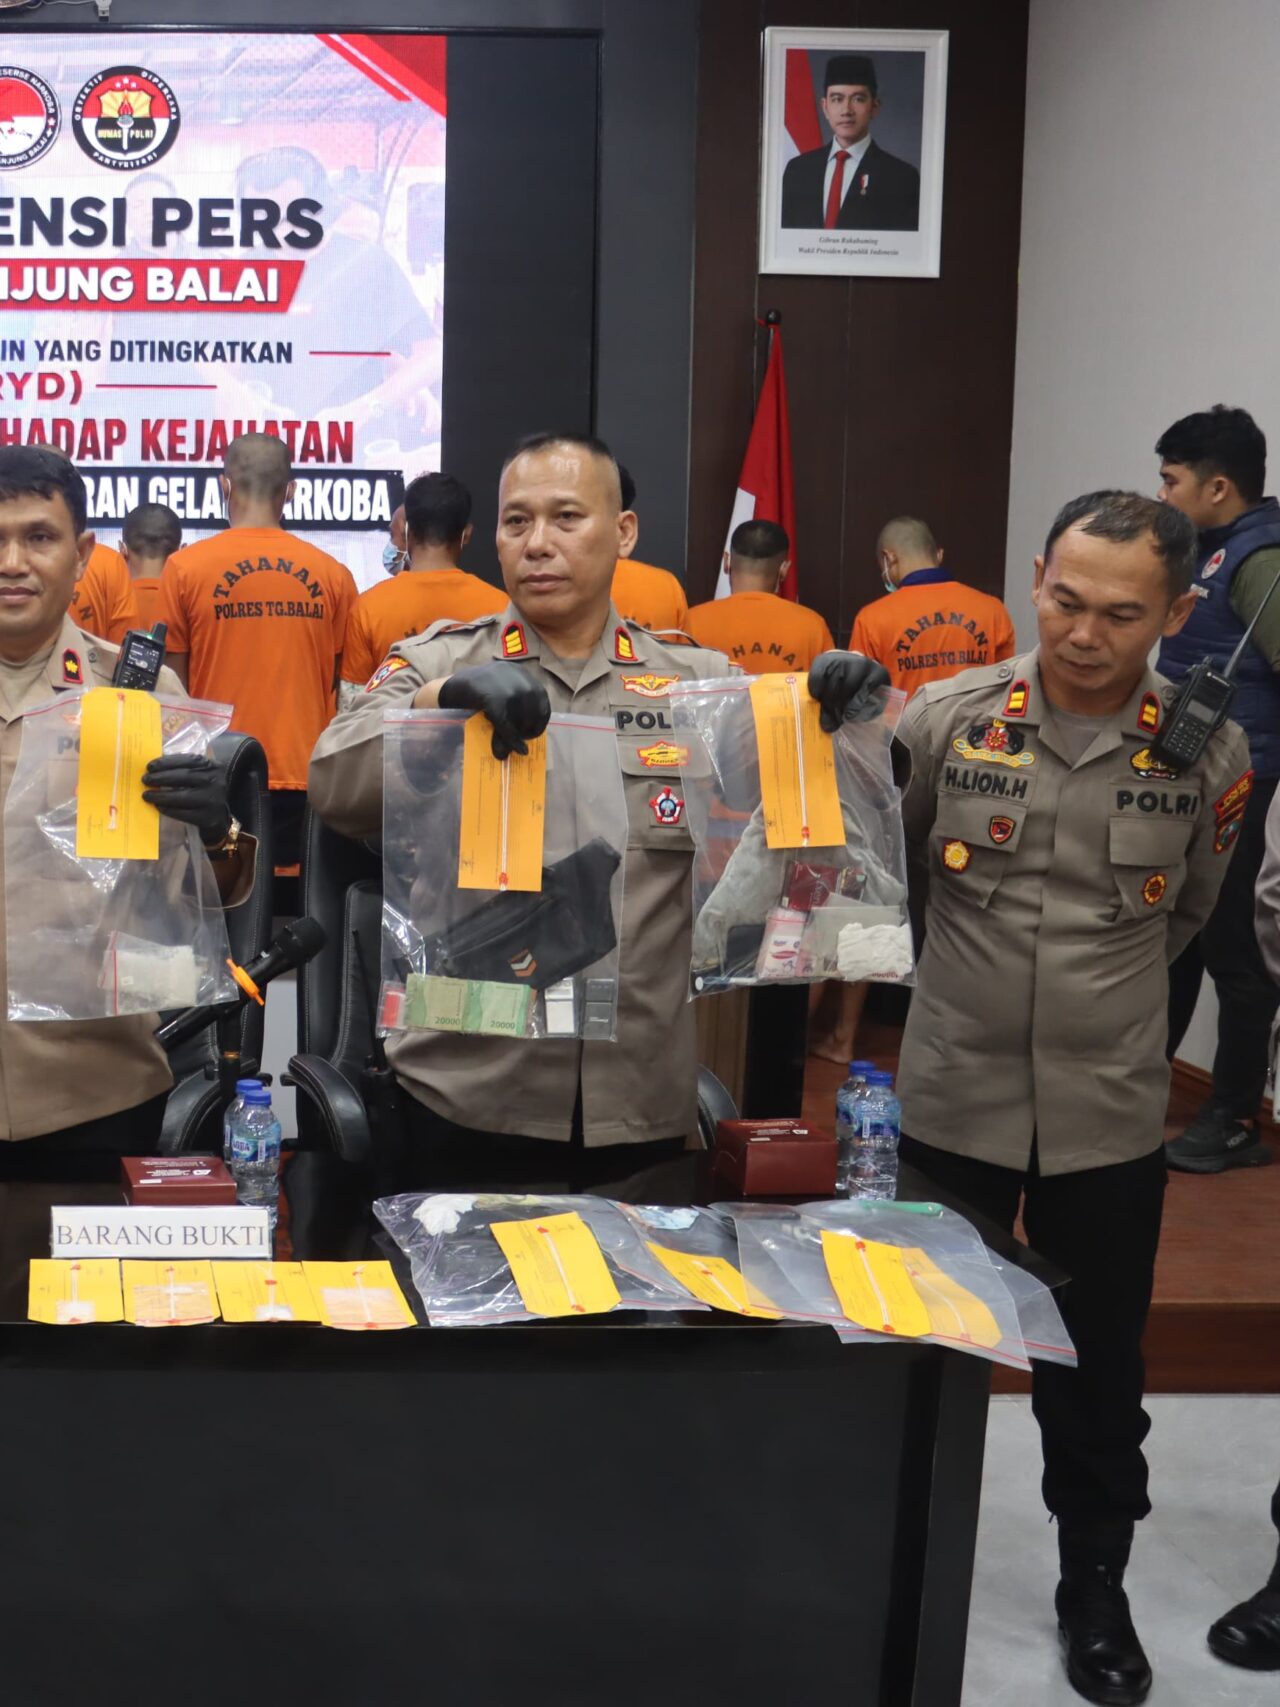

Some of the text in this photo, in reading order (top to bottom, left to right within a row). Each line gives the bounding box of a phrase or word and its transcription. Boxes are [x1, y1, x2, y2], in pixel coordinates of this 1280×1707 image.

[30, 77, 56, 114] NARKOBA
[28, 136, 48, 159] BALAI
[129, 129, 154, 139] POLRI
[151, 196, 324, 250] PERS
[146, 266, 279, 302] BALAI
[34, 339, 102, 363] YANG
[110, 340, 293, 364] DITINGKATKAN
[147, 476, 229, 520] GELA
[280, 478, 392, 522] ARKOBA
[212, 556, 324, 601] TAHANAN
[214, 601, 264, 621] POLRES
[896, 611, 989, 653] TAHANAN
[732, 641, 804, 672] HANA
[897, 652, 939, 672] POLRES
[944, 767, 1029, 800] H.LION.H
[1116, 789, 1199, 816] POLRI
[56, 1224, 265, 1246] BARANG BUKTI
